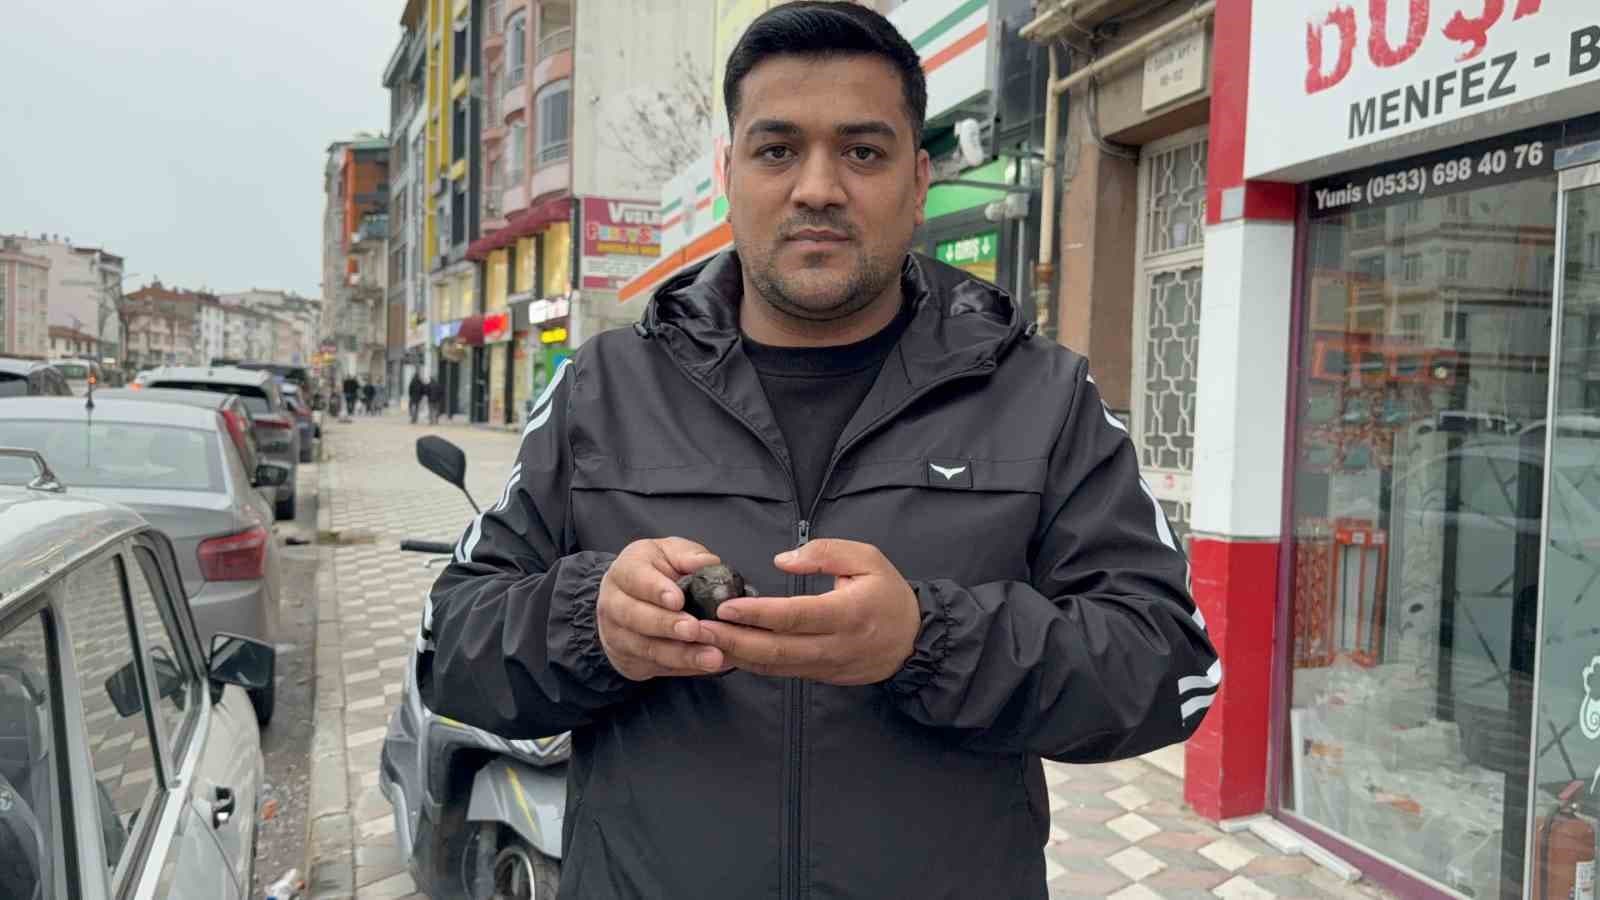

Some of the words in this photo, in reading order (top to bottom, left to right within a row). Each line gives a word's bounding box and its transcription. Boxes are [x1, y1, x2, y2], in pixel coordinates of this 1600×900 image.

[1305, 0, 1543, 94] DUŞ
[1347, 50, 1518, 140] MENFEZ
[1314, 182, 1362, 210] Yunis
[1366, 166, 1427, 204] (0533)
[1432, 156, 1472, 185] 698
[1477, 149, 1507, 175] 40
[1513, 141, 1544, 169] 76
